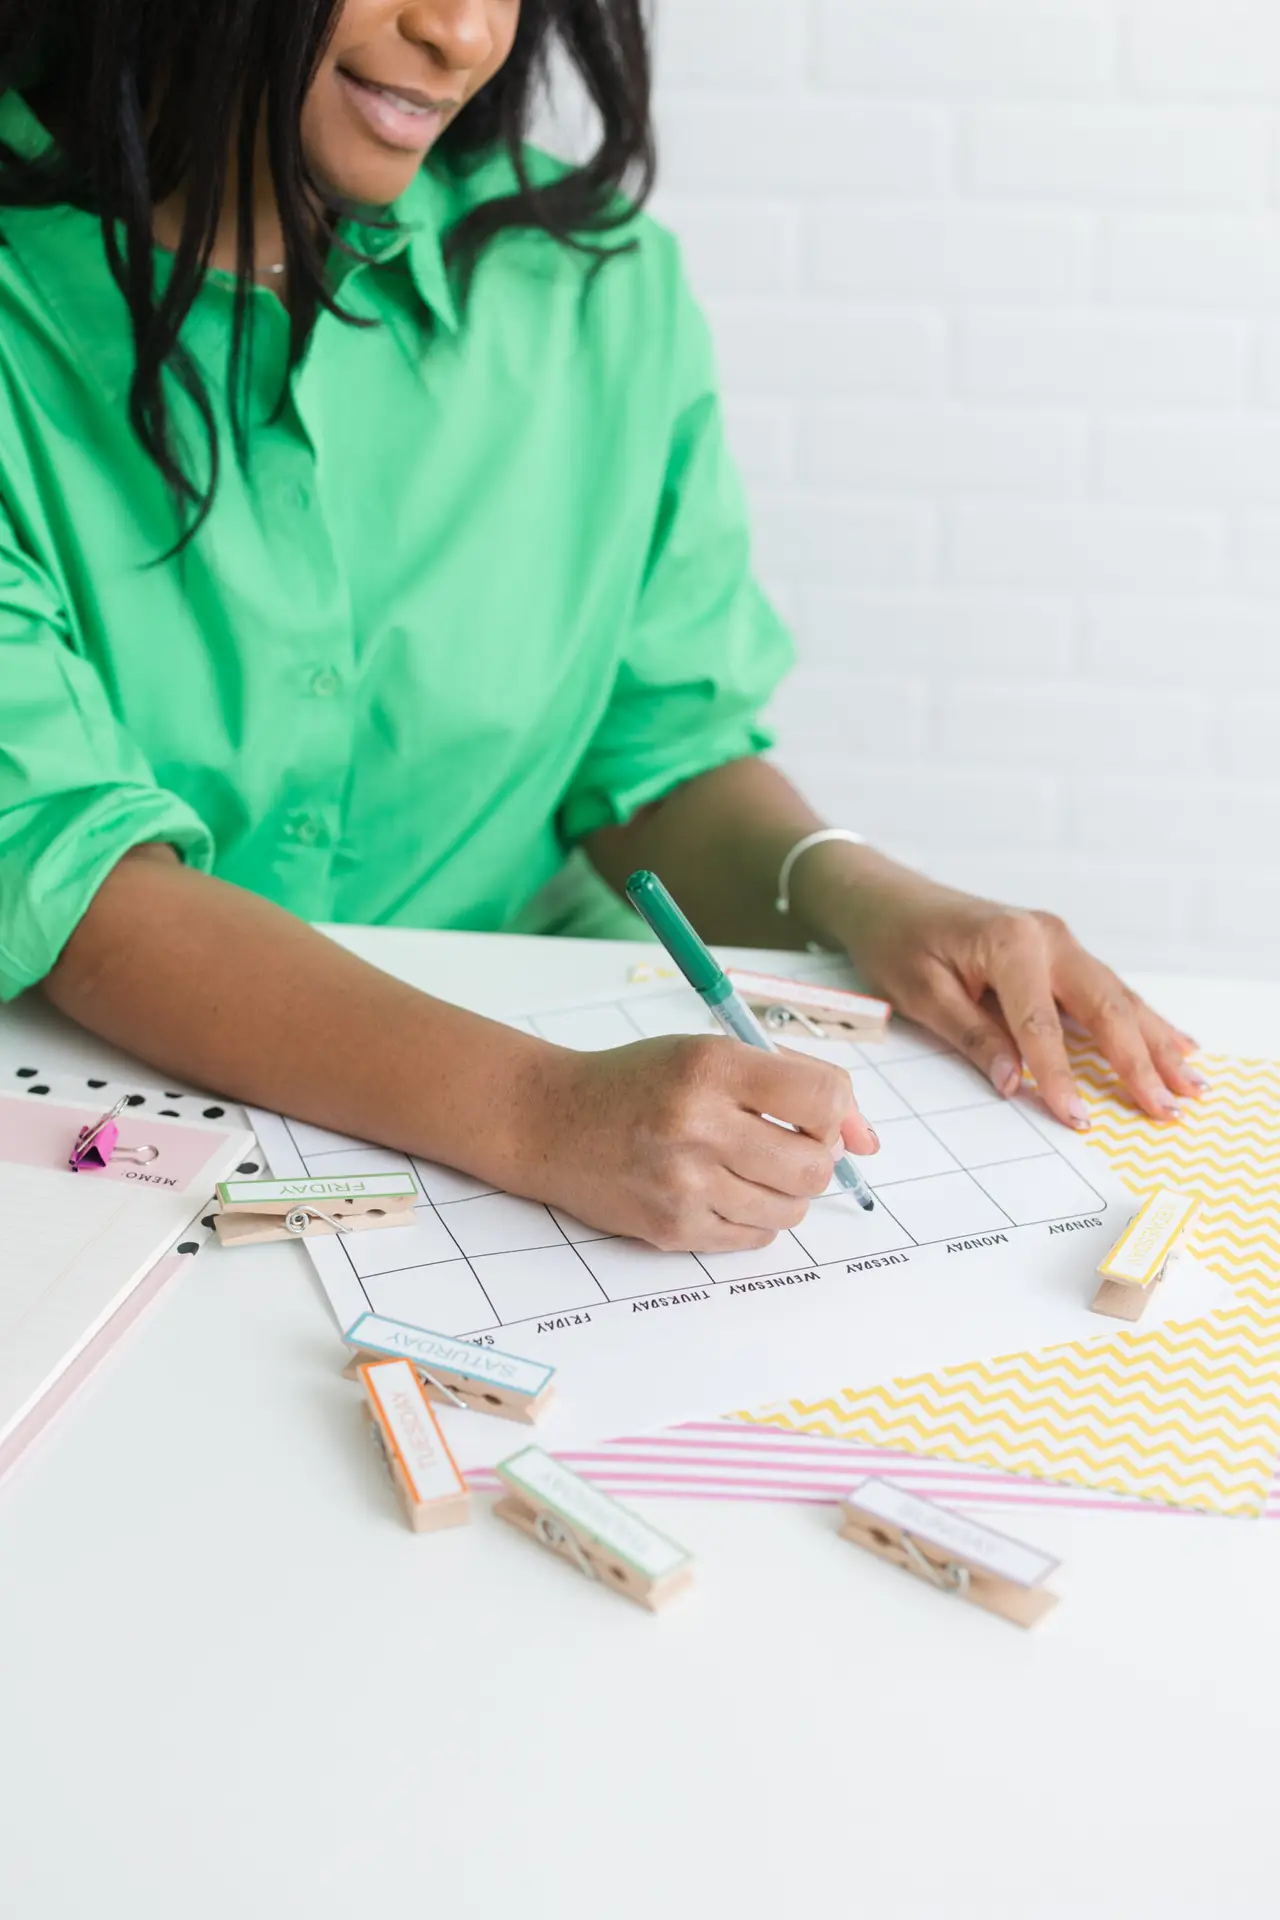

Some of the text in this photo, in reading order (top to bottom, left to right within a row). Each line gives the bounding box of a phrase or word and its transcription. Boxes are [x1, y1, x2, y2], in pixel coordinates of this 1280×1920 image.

[280, 1181, 365, 1195] FRIDAY
[536, 1217, 1103, 1334] SUNDAY MONDAY TUESDAY WEDNESDAY THURSDAY FRIDAY
[386, 1331, 518, 1379] SATURDAY
